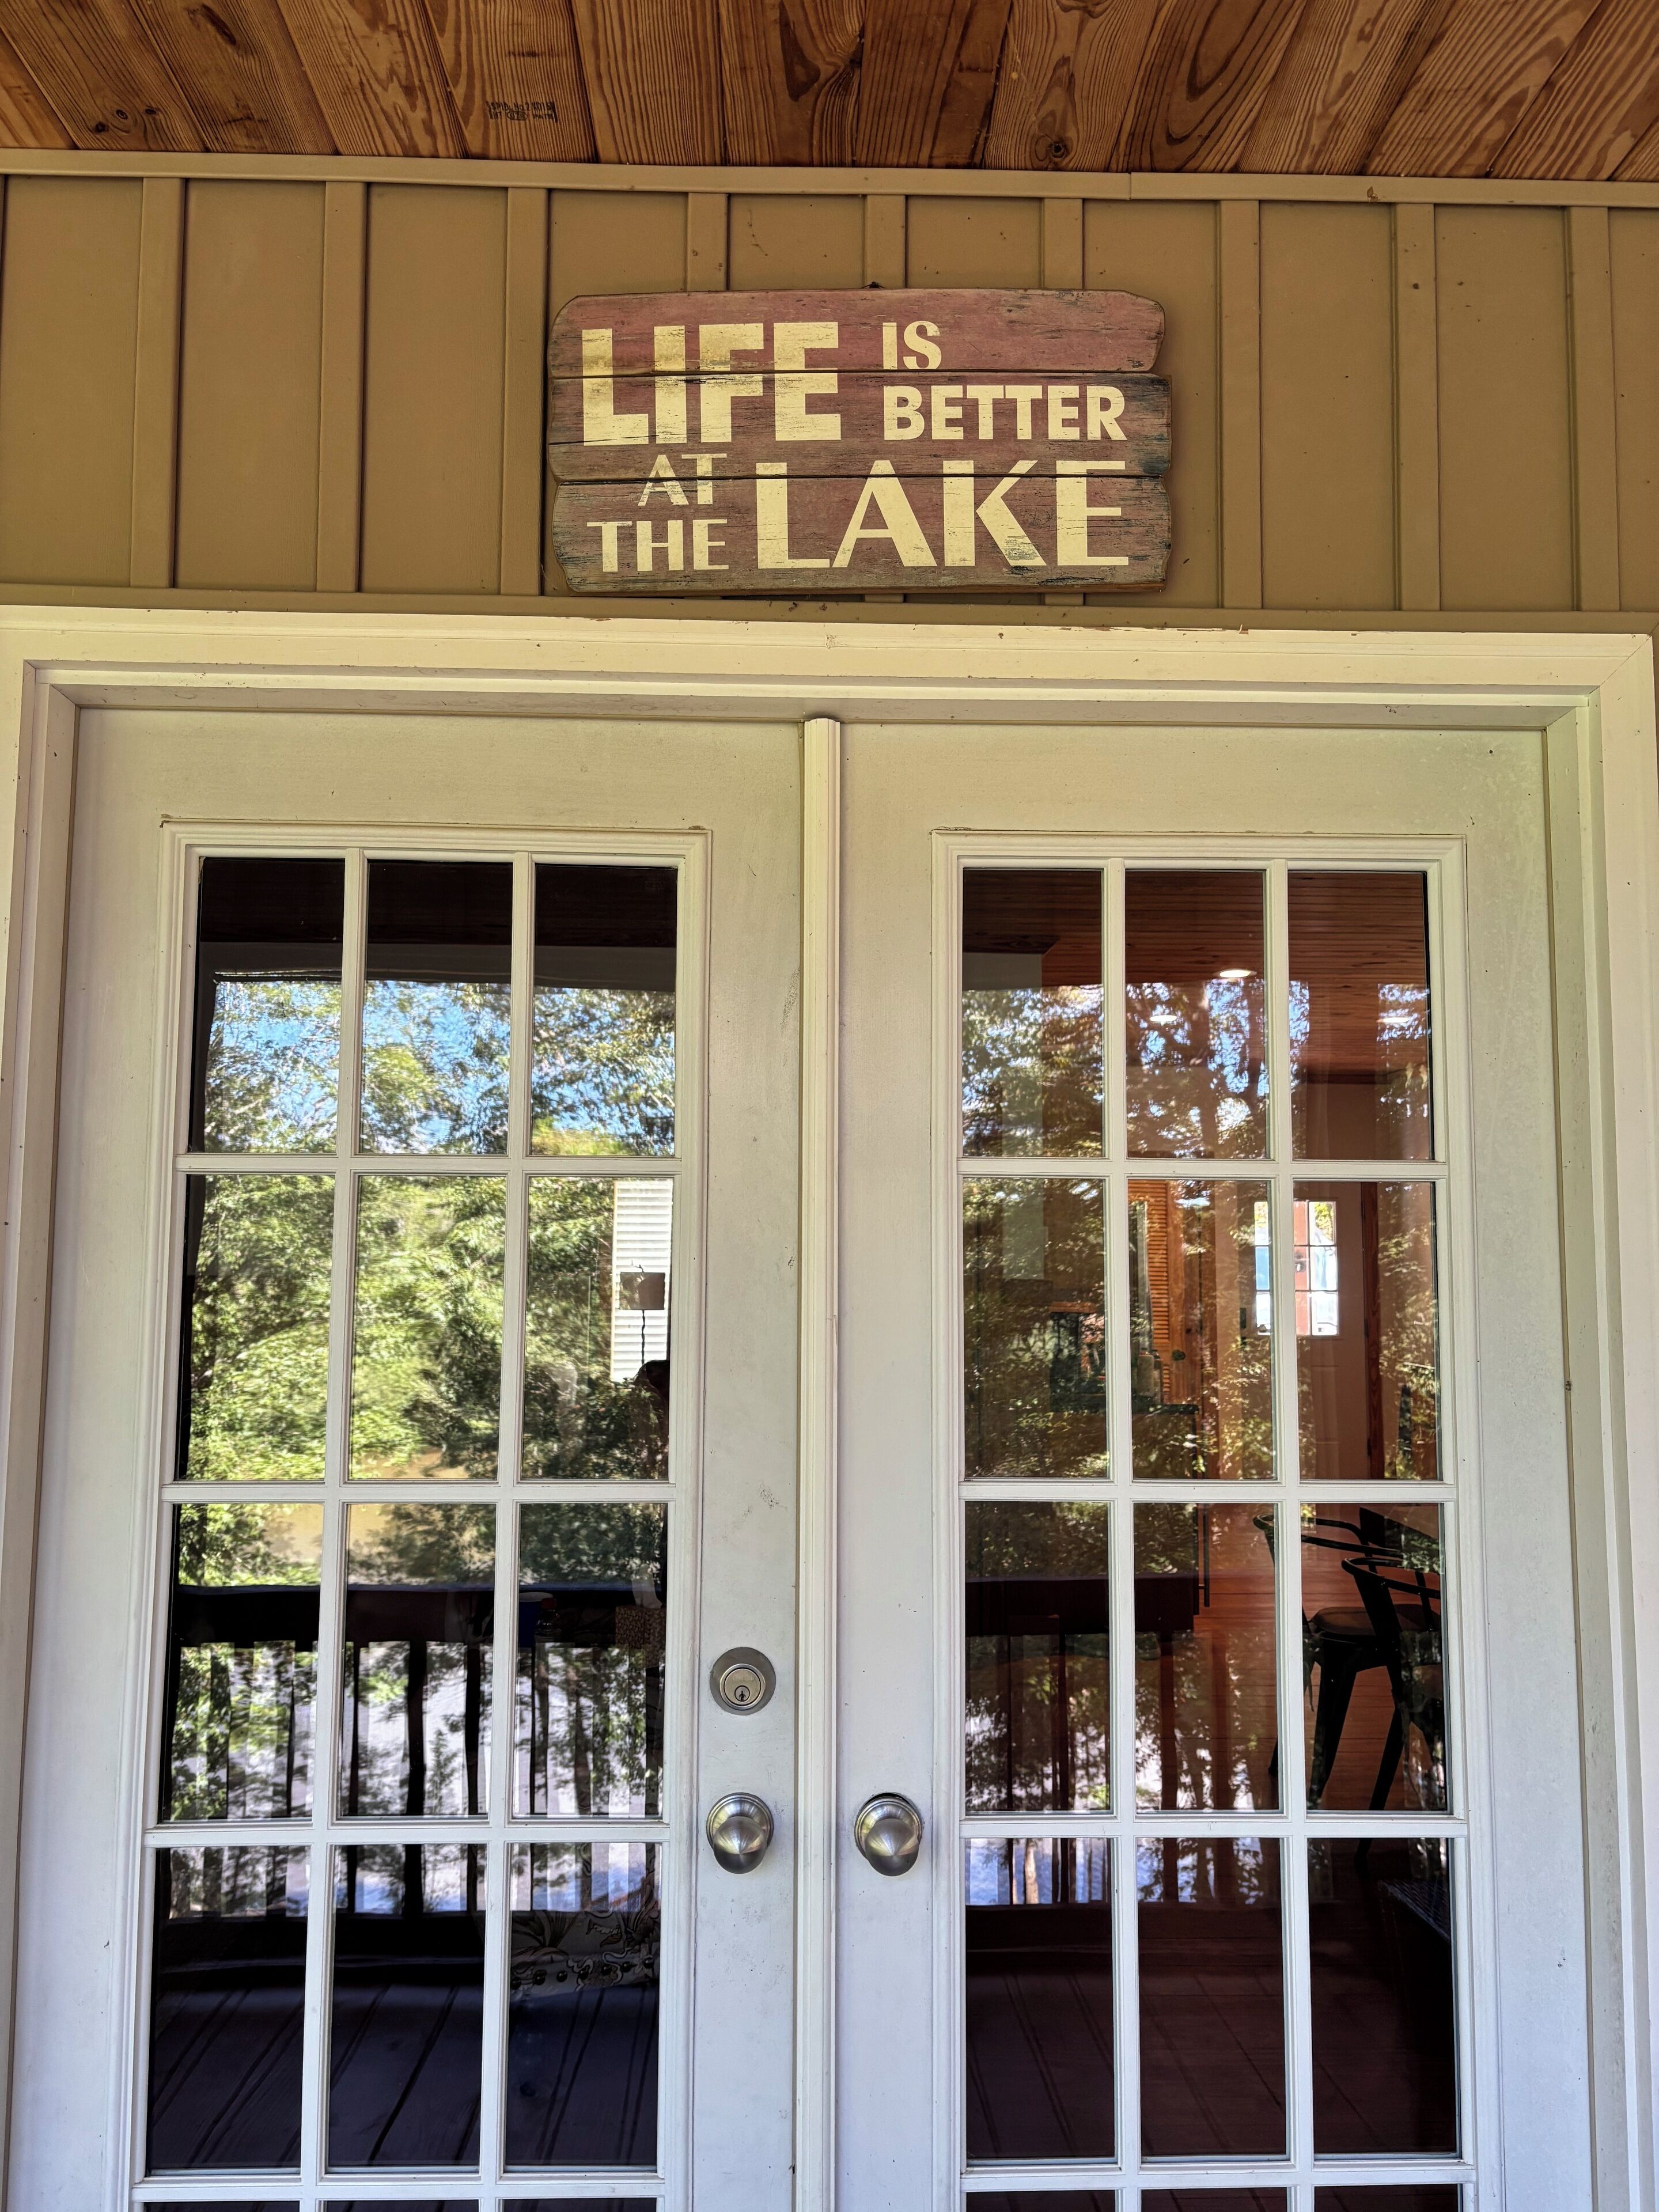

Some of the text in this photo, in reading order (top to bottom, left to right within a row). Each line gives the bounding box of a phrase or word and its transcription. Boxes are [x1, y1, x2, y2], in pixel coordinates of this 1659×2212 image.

[883, 321, 941, 369] IS
[582, 322, 841, 446] LIFE
[884, 385, 1127, 440] BETTER
[638, 453, 726, 506] AT
[756, 460, 1128, 569] LAKE
[587, 519, 729, 571] THE
